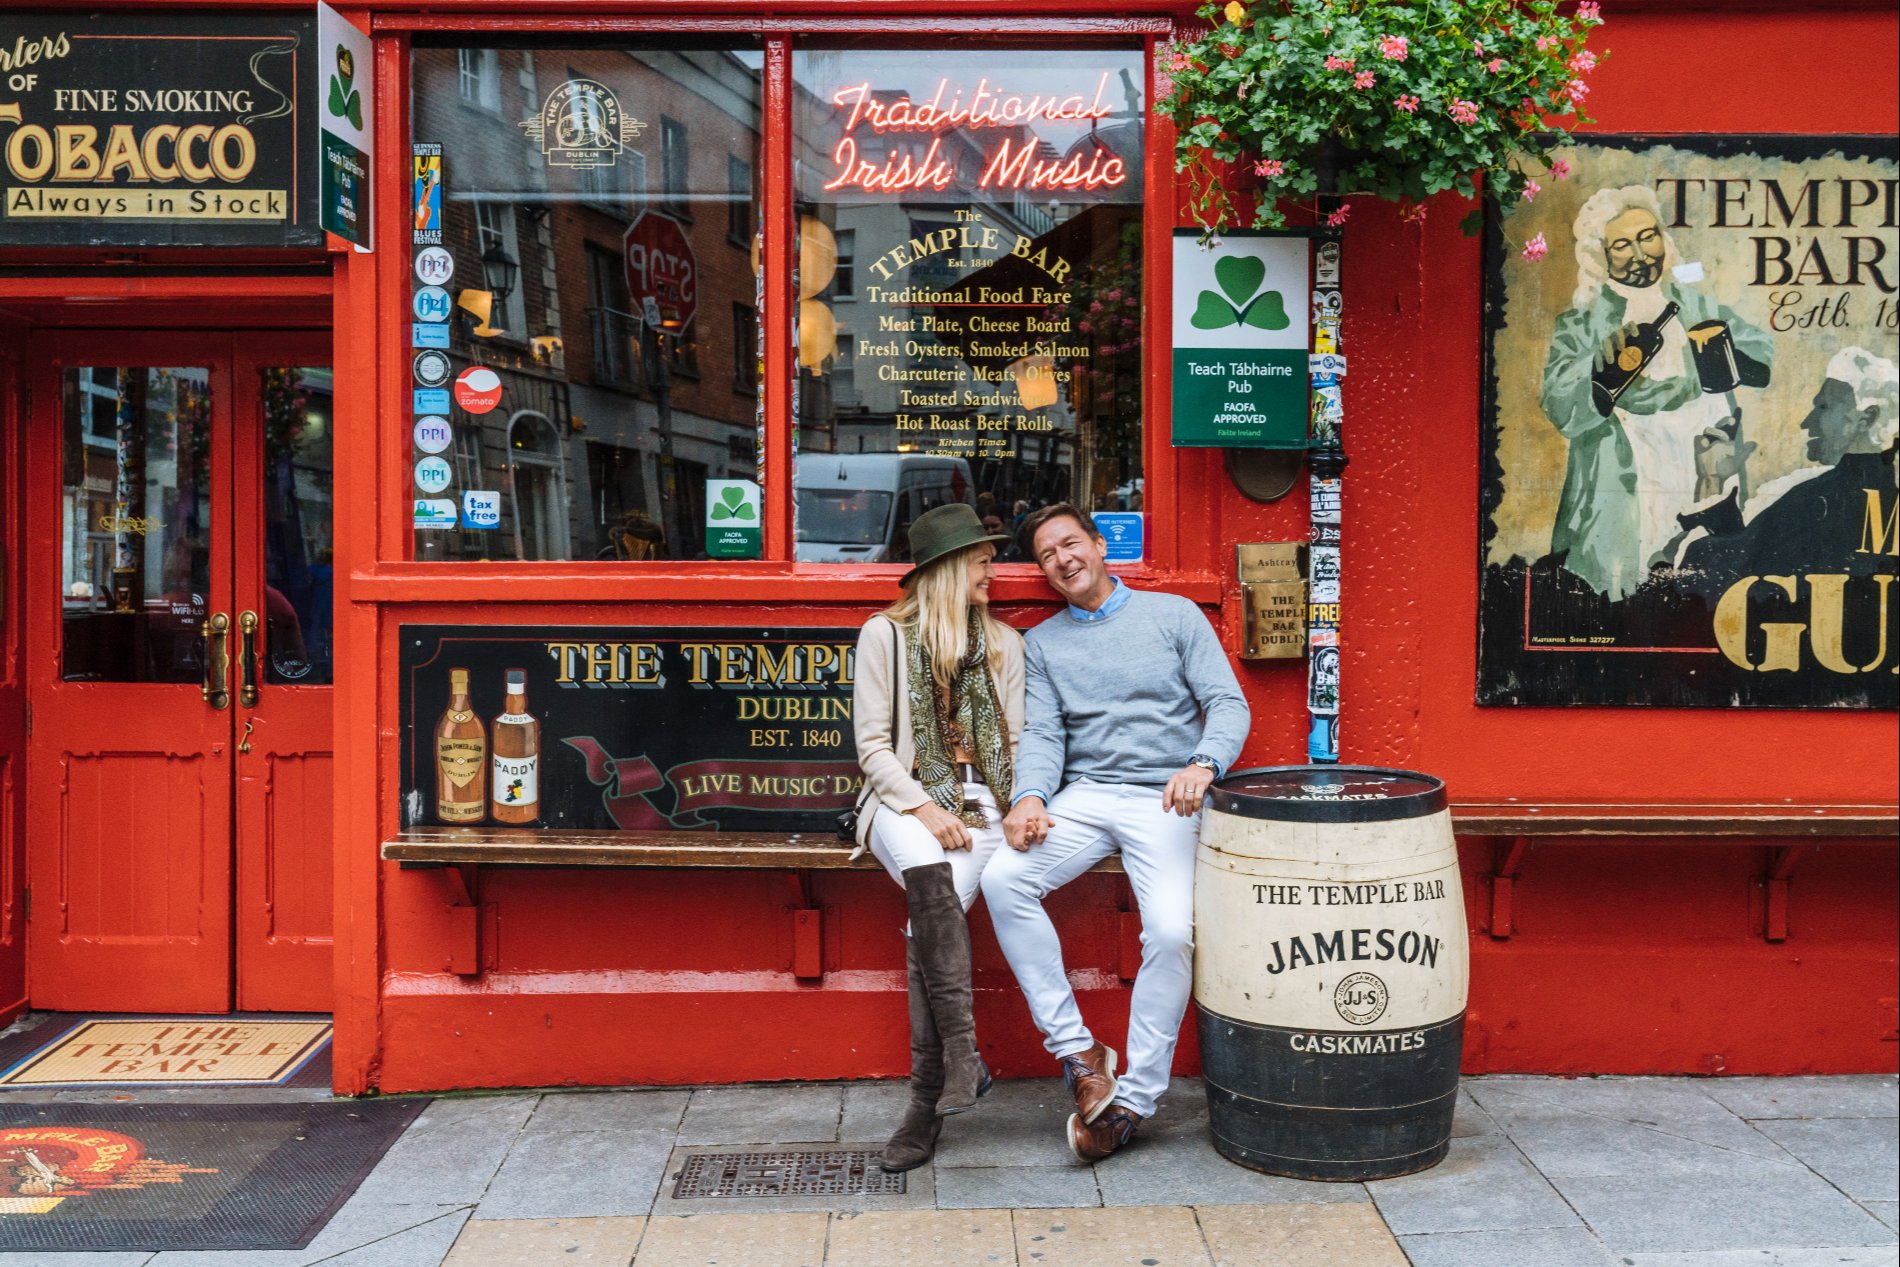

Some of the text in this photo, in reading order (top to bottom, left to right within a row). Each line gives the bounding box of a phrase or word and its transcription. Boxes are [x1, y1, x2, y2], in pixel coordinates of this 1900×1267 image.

[0, 31, 70, 72] rters
[8, 74, 38, 92] OF
[54, 89, 254, 113] FINE SMOKING
[546, 84, 617, 126] THE TEMPLE BAR
[833, 71, 1112, 130] Traditional
[0, 103, 257, 183] OBACCO
[824, 136, 1126, 189] Irish Music
[12, 189, 281, 216] Always in Stock
[1655, 178, 1899, 229] TEMPL
[954, 209, 982, 223] The
[414, 230, 442, 238] BLUES
[414, 237, 442, 245] FESTIVAL
[869, 227, 1073, 284] TEMPLE BAR
[947, 258, 993, 268] Est. 1840
[1748, 236, 1898, 294] BAR
[866, 285, 1071, 304] Traditional Food Fare
[879, 315, 1071, 335] Meat Plate, Cheese Board
[859, 340, 1090, 362] Fresh Oysters, Smoked Salmon
[878, 365, 967, 382] Charcuterie
[1026, 365, 1071, 382] Olives
[1188, 361, 1293, 376] Teach Tábhairne
[1228, 380, 1252, 393] Pub
[900, 389, 1047, 407] Toasted Sandwic
[1224, 402, 1256, 412] FAOFA
[896, 414, 1053, 431] Hot Roast Beef Rolls
[1213, 414, 1267, 424] APPROVED
[421, 428, 445, 440] PPI
[939, 438, 1007, 446] Kitchen Times
[422, 469, 445, 481] PPI
[469, 497, 492, 509] tax
[469, 510, 497, 520] free
[1855, 488, 1899, 556] M
[1258, 559, 1296, 568] Ashtray
[1271, 596, 1295, 605] THE
[1261, 609, 1306, 619] TEMPLE
[1272, 622, 1295, 631] BAR
[1713, 574, 1899, 674] GU
[1261, 635, 1306, 645] DUBLIN
[547, 643, 854, 688] THE TEMPL
[737, 696, 852, 721] DUBLIN
[503, 715, 530, 723] PADDY
[750, 729, 842, 747] EST. 1840
[494, 758, 537, 776] PADDY
[682, 774, 864, 797] LIVE MUSIC DA
[1253, 879, 1445, 905] THE TEMPLE BAR
[1266, 928, 1440, 975] JAMESON
[1338, 975, 1384, 997] JOHN JAMESON
[1341, 1009, 1357, 1022] SON
[1359, 1001, 1384, 1022] LIMITED
[153, 1026, 261, 1040] THE
[70, 1042, 301, 1057] TEMPLE
[1290, 1032, 1425, 1054] CASKMATES
[99, 1059, 219, 1073] BAR
[4, 1132, 110, 1147] MPLE
